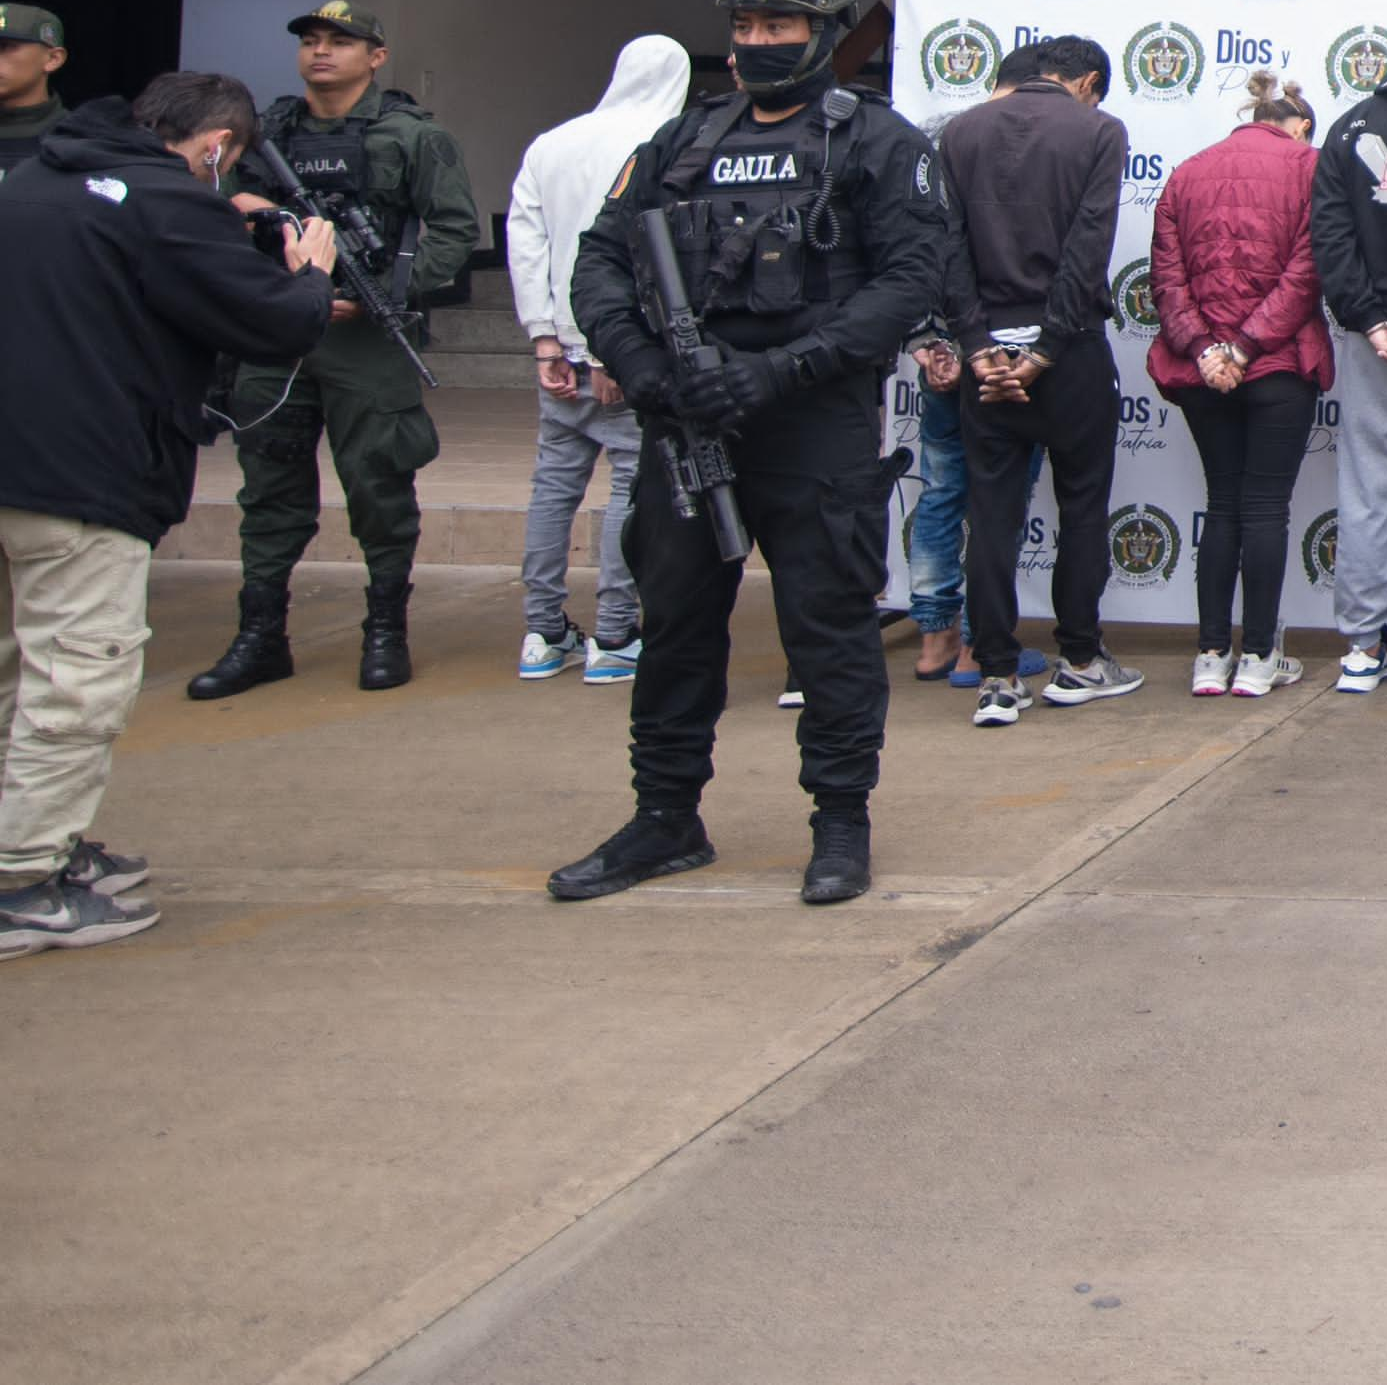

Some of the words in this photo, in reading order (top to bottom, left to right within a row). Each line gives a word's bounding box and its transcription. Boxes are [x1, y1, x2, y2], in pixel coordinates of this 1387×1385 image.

[1216, 30, 1272, 64] Dios
[1281, 51, 1290, 69] y
[294, 159, 348, 174] GAULA
[712, 153, 798, 184] GAULA
[1124, 145, 1163, 180] ios
[894, 381, 924, 416] Dio
[1119, 396, 1150, 423] os
[1159, 409, 1168, 428] y
